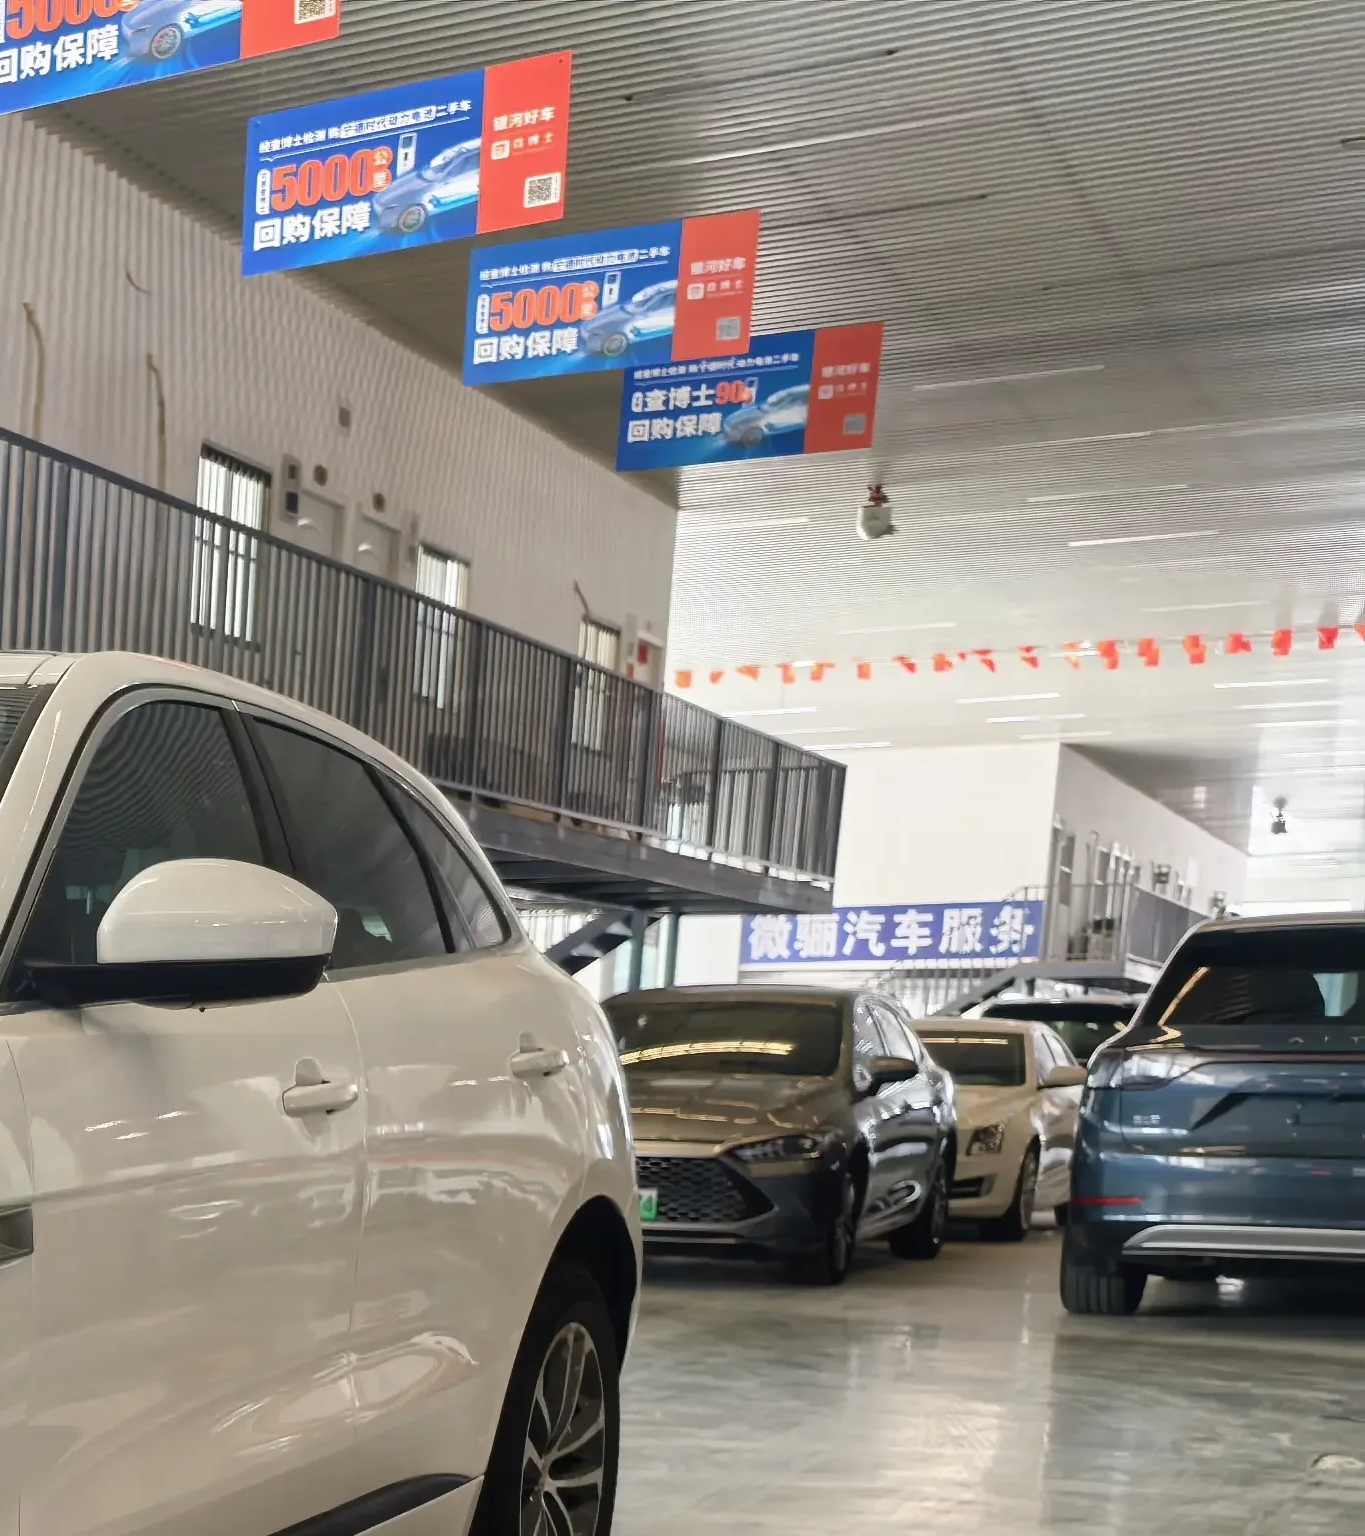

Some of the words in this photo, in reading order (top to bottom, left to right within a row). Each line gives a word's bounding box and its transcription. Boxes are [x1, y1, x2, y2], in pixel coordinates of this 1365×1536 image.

[271, 149, 373, 211] 5000
[253, 202, 371, 251] 回购保障
[490, 283, 581, 332] 5000
[473, 328, 579, 364] 回购保障
[628, 412, 722, 443] 回购保障
